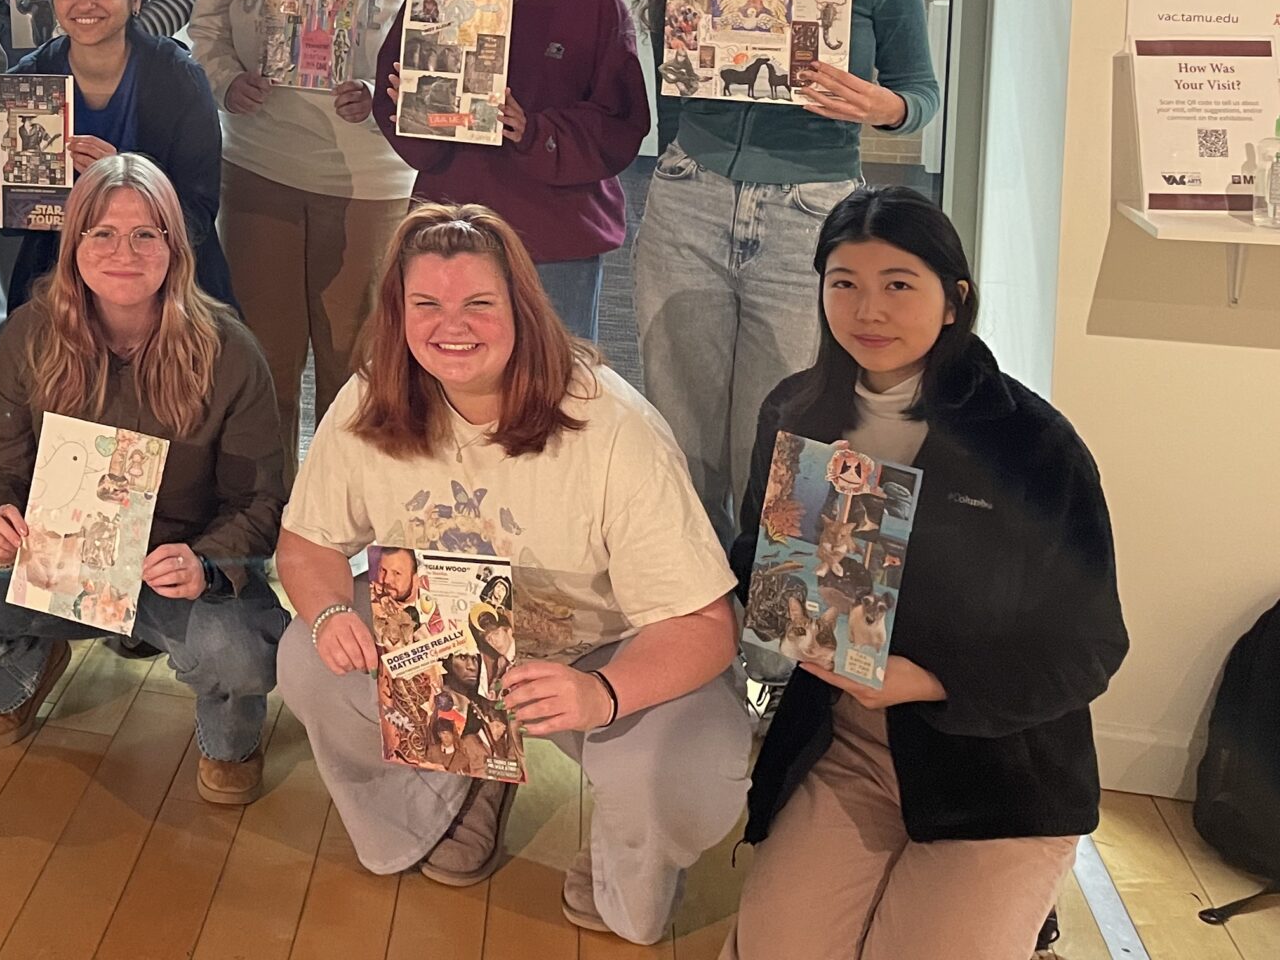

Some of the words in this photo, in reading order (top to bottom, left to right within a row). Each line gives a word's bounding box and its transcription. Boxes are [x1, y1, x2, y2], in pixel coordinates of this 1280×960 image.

[1158, 14, 1238, 23] vac.tamu.edu
[1179, 63, 1206, 73] How
[1210, 63, 1235, 73] Was
[1175, 80, 1203, 90] Your
[1207, 80, 1241, 90] Visit?
[31, 204, 64, 215] STAR
[28, 214, 64, 226] TOUR
[386, 653, 410, 665] DOES
[410, 644, 431, 656] SIZE
[431, 630, 464, 648] REALLY
[389, 652, 428, 672] MATTER?
